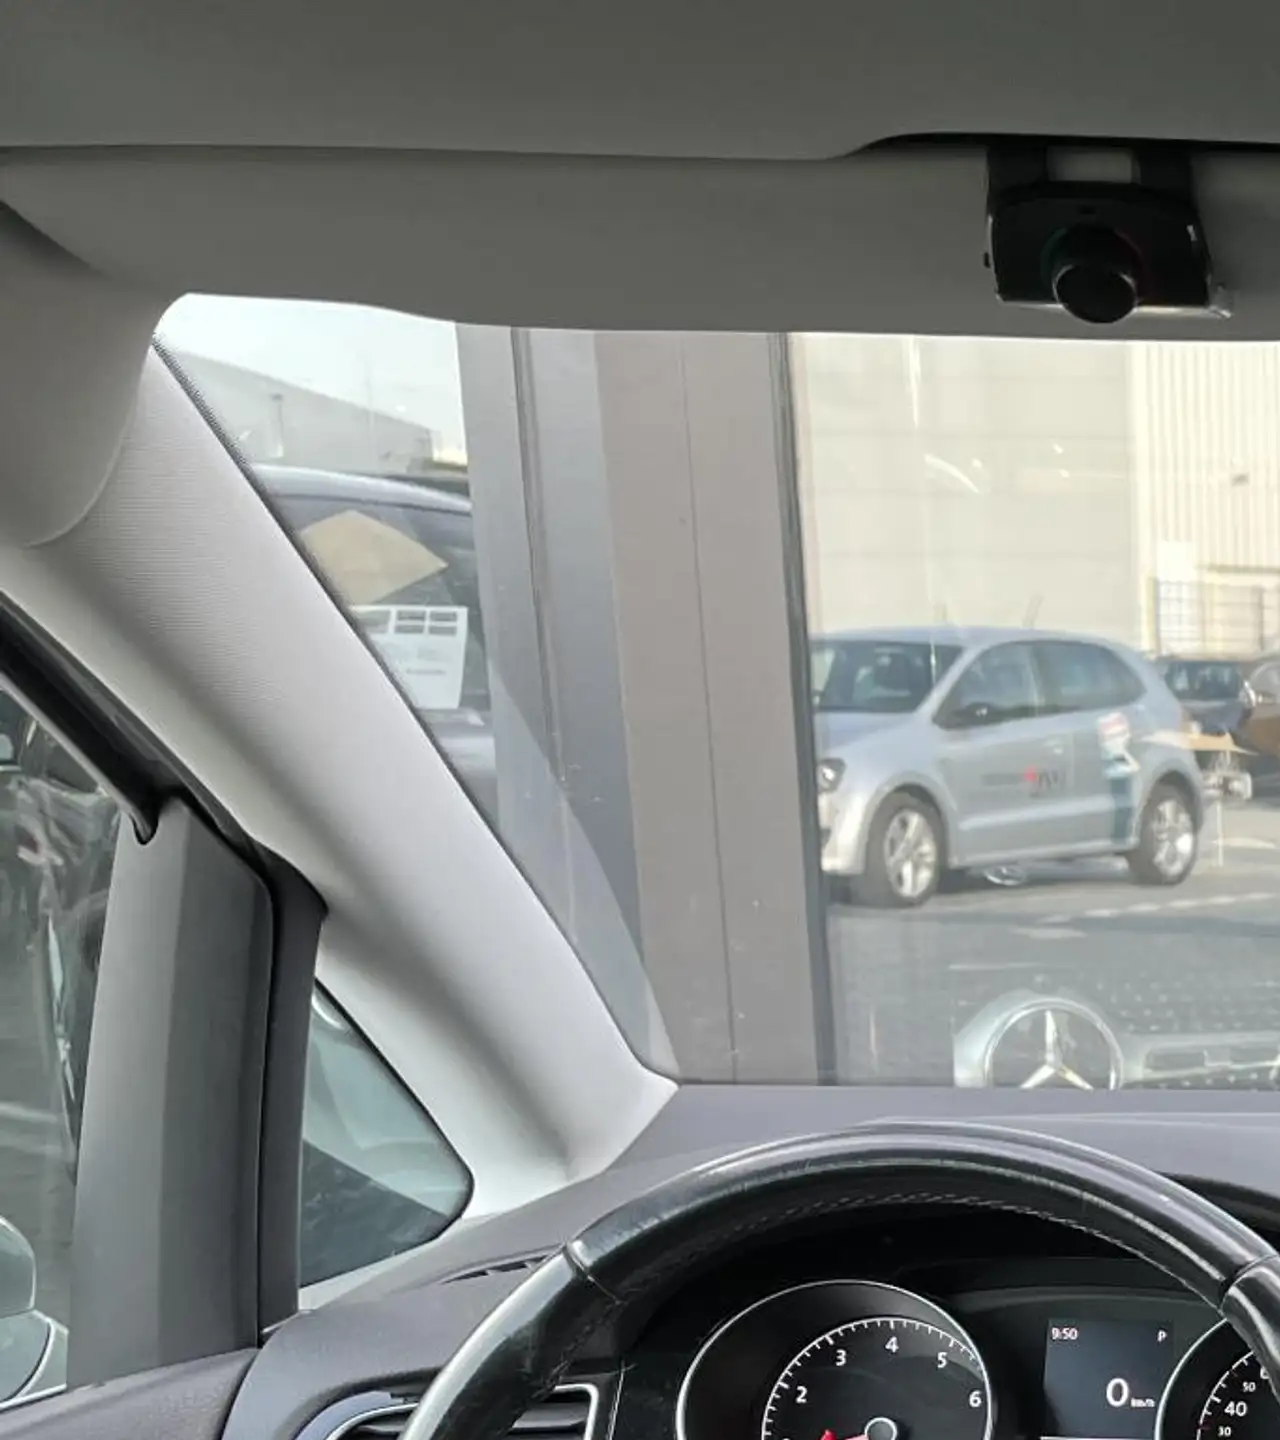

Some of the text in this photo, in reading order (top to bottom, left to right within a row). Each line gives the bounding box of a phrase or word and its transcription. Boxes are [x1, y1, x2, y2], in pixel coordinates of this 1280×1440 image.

[1051, 1327, 1079, 1340] 9:50
[1157, 1330, 1168, 1342] P
[885, 1336, 899, 1352] 4
[835, 1350, 847, 1366] 3
[937, 1352, 948, 1368] 5
[795, 1385, 808, 1403] 2
[1106, 1378, 1129, 1407] 0
[1242, 1381, 1256, 1392] 50
[969, 1390, 982, 1407] 6
[1224, 1401, 1248, 1417] 40
[1218, 1426, 1231, 1437] 30
